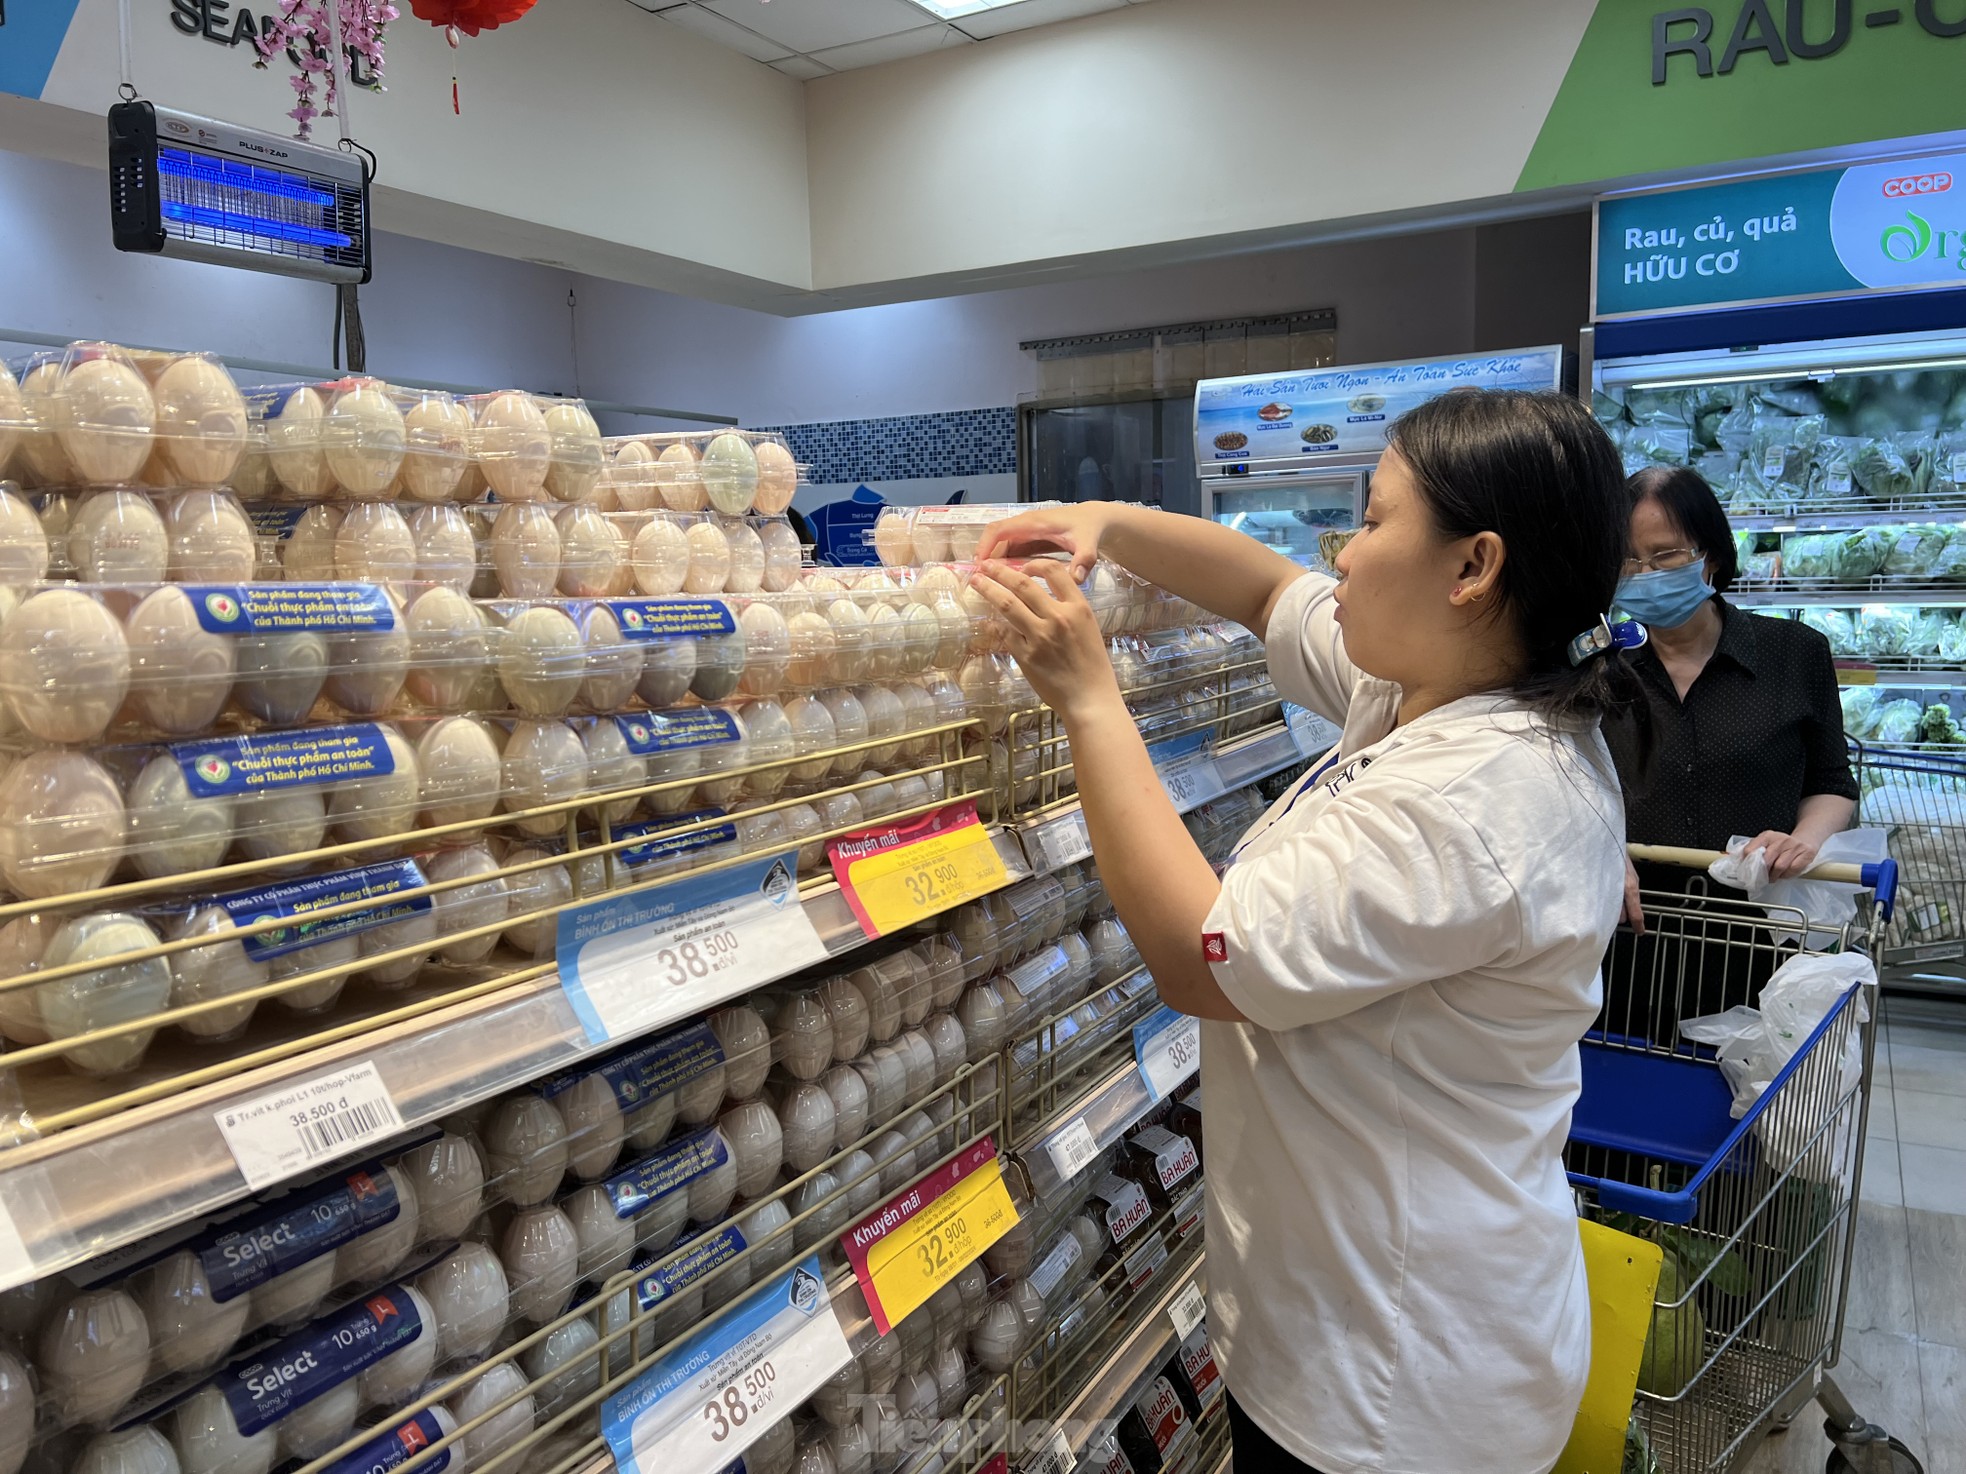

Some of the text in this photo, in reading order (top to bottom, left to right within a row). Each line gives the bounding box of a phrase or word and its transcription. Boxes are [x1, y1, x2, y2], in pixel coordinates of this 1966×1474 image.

[1884, 174, 1950, 197] COOP
[1625, 206, 1797, 250] Rau, củ, quả
[1624, 249, 1740, 285] HỮU CƠ
[1336, 373, 1369, 392] Ngon
[1384, 369, 1407, 384] An
[298, 591, 321, 600] đang
[306, 602, 334, 613] phẩm
[274, 615, 303, 626] Thành
[343, 736, 358, 747] gia
[273, 755, 297, 769] thực
[300, 751, 330, 766] phẩm
[332, 750, 345, 760] an
[246, 772, 264, 784] của
[266, 769, 296, 782] Thành
[298, 765, 316, 779] phố
[318, 764, 331, 775] Hồ
[333, 762, 348, 773] Chí
[837, 833, 879, 859] Khuyến
[879, 828, 900, 848] mãi
[934, 863, 958, 884] 900
[253, 893, 264, 905] TY
[293, 880, 400, 913] Sản phẩm đang gia
[705, 930, 739, 957] 500
[1183, 1032, 1196, 1050] 500
[296, 1090, 310, 1101] L1
[289, 1101, 336, 1128] 38.500
[1161, 1151, 1196, 1185] BA HUÂN
[358, 1182, 368, 1191] L
[852, 1206, 901, 1248] Khuyến
[900, 1189, 921, 1216] mãi
[1111, 1198, 1149, 1238] BA HUÂN
[223, 1222, 295, 1268] Select
[310, 1205, 332, 1224] 10
[944, 1217, 966, 1244] 900
[696, 1250, 711, 1266] phẩm
[711, 1247, 719, 1256] an
[376, 1304, 389, 1314] L
[246, 1350, 318, 1400] Select
[332, 1329, 353, 1350] 10
[356, 1327, 370, 1339] 650
[1185, 1355, 1198, 1374] BA
[618, 1351, 710, 1423] BÌNH ỔN THỊ TRƯỜNG
[744, 1360, 776, 1396] 500
[617, 1393, 631, 1407] Sản
[1149, 1388, 1175, 1419] HUÂN
[407, 1433, 420, 1445] L
